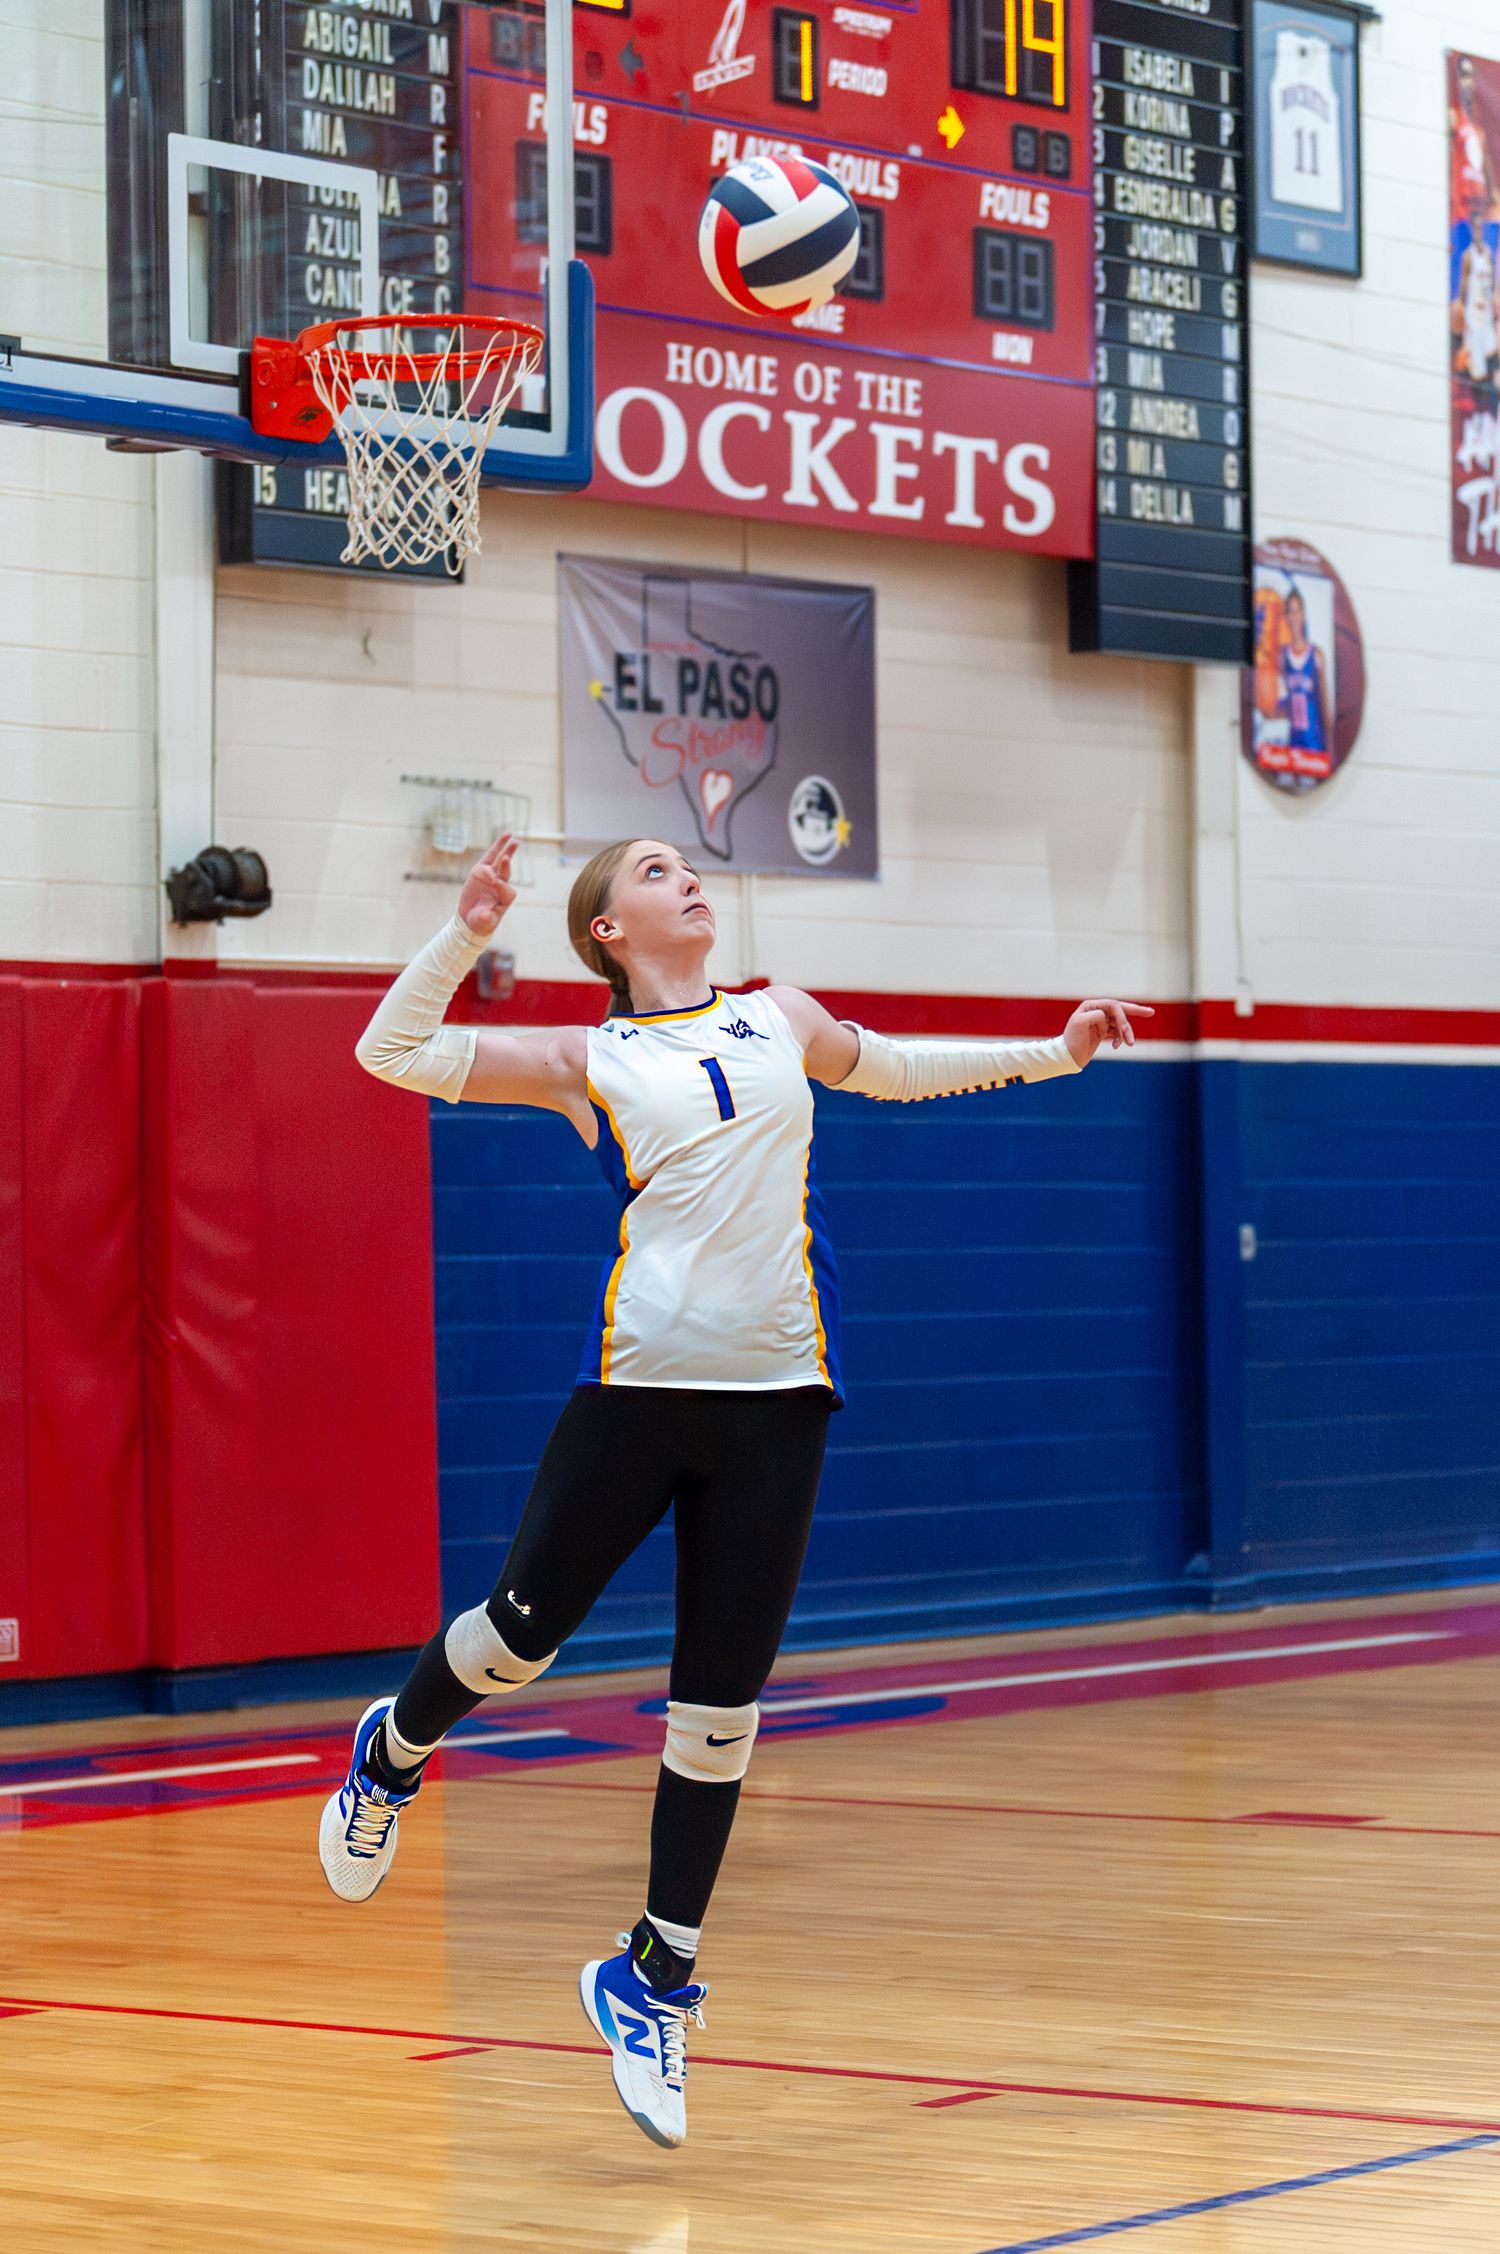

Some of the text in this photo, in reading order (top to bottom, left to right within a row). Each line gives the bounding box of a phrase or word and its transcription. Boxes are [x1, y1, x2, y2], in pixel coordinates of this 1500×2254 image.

[303, 9, 395, 64] ABIGAIL
[800, 20, 814, 102] 1
[303, 58, 446, 125] DALILAH R
[828, 58, 888, 96] PERIOD
[303, 109, 446, 174] MIA F
[527, 92, 607, 144] FLS
[827, 153, 900, 200] FOULS
[1124, 134, 1196, 182] GISELLE
[1294, 127, 1320, 177] 11
[433, 184, 448, 224] R
[979, 182, 1050, 229] FOULS
[1114, 176, 1217, 230] ESMERALDA
[305, 213, 450, 275] AZUL B
[1127, 222, 1199, 268] JORDAN
[1128, 310, 1175, 350] HOPE
[666, 343, 922, 417] HOME OF THE
[530, 373, 1056, 537] OCKETS
[254, 464, 277, 505] 15
[614, 652, 780, 722] EL PASO
[698, 1056, 736, 1122] 1
